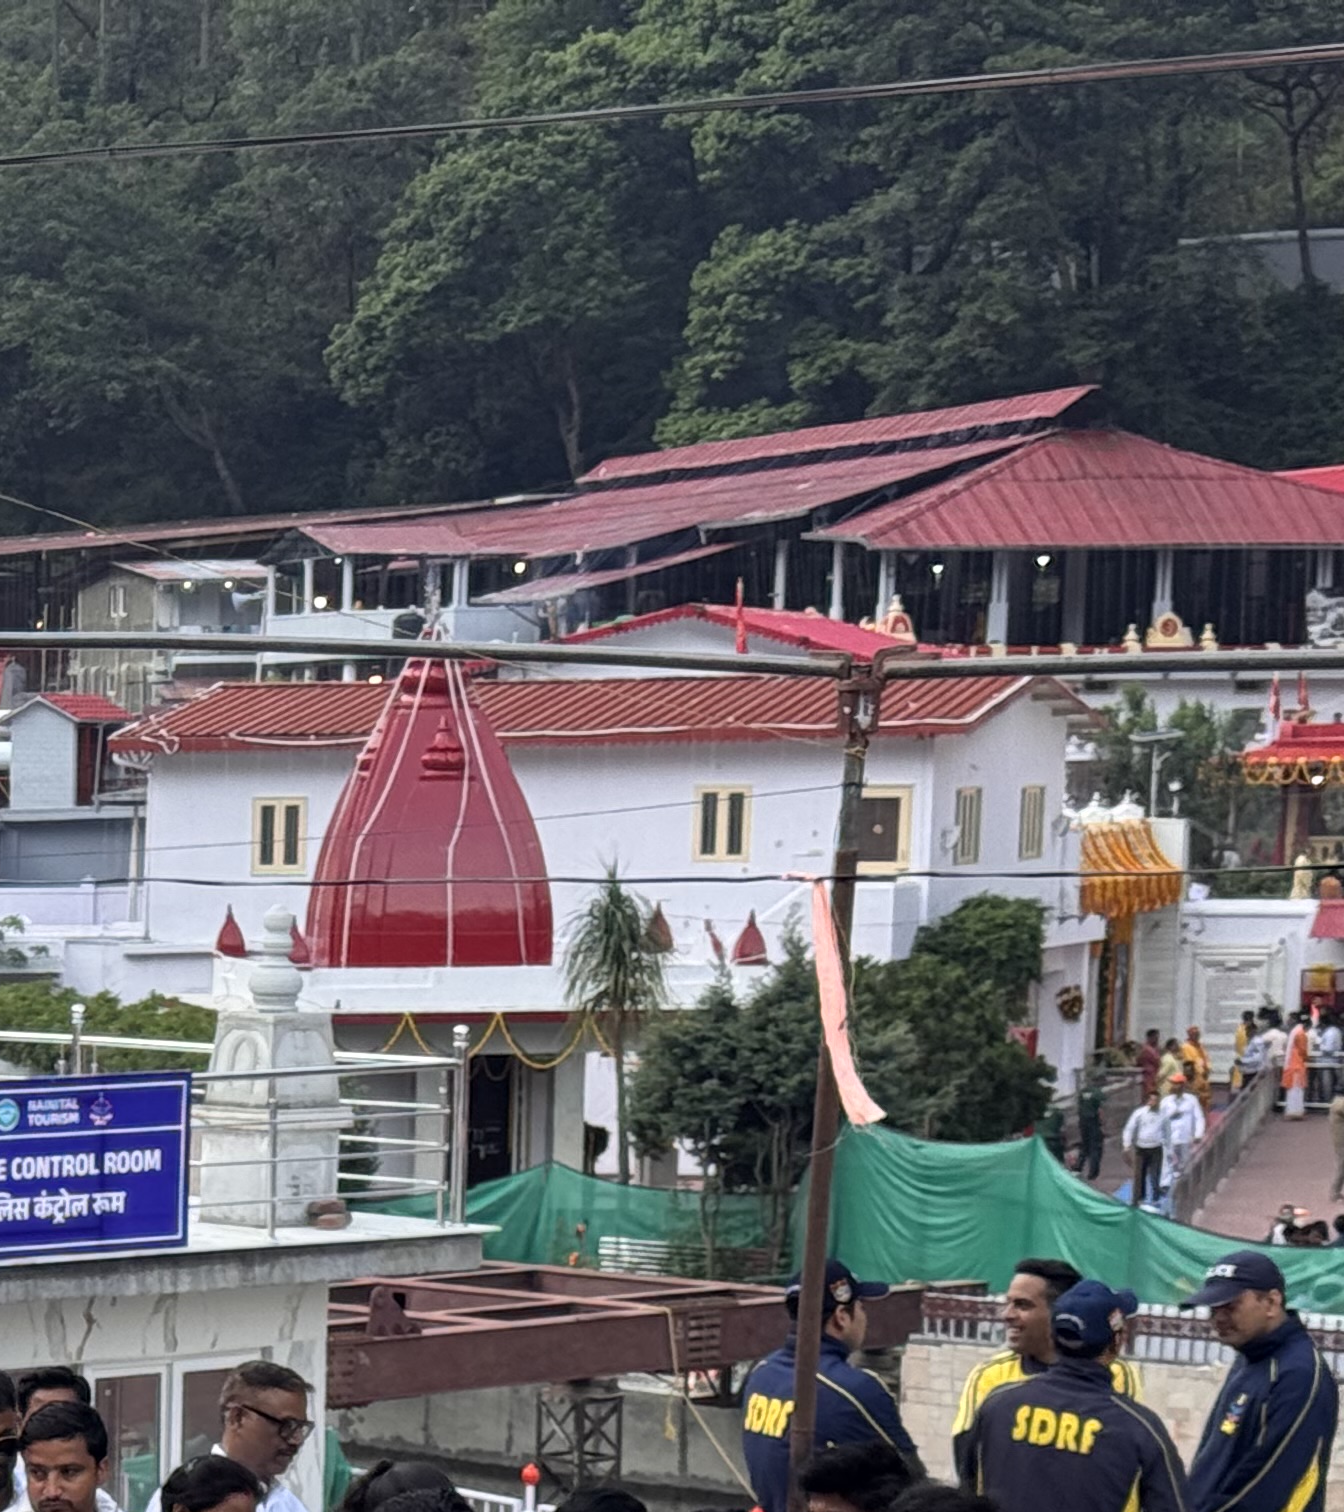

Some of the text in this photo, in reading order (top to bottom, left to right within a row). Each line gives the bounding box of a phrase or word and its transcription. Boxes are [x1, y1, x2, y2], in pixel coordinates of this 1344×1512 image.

[27, 1112, 80, 1126] TOURISM
[11, 1153, 100, 1180] CONTROL
[104, 1148, 162, 1173] ROOM
[33, 1188, 90, 1224] कंट्रोल
[92, 1191, 126, 1215] रूम
[744, 1393, 795, 1438] SDRF
[1012, 1405, 1103, 1454] SDRF
